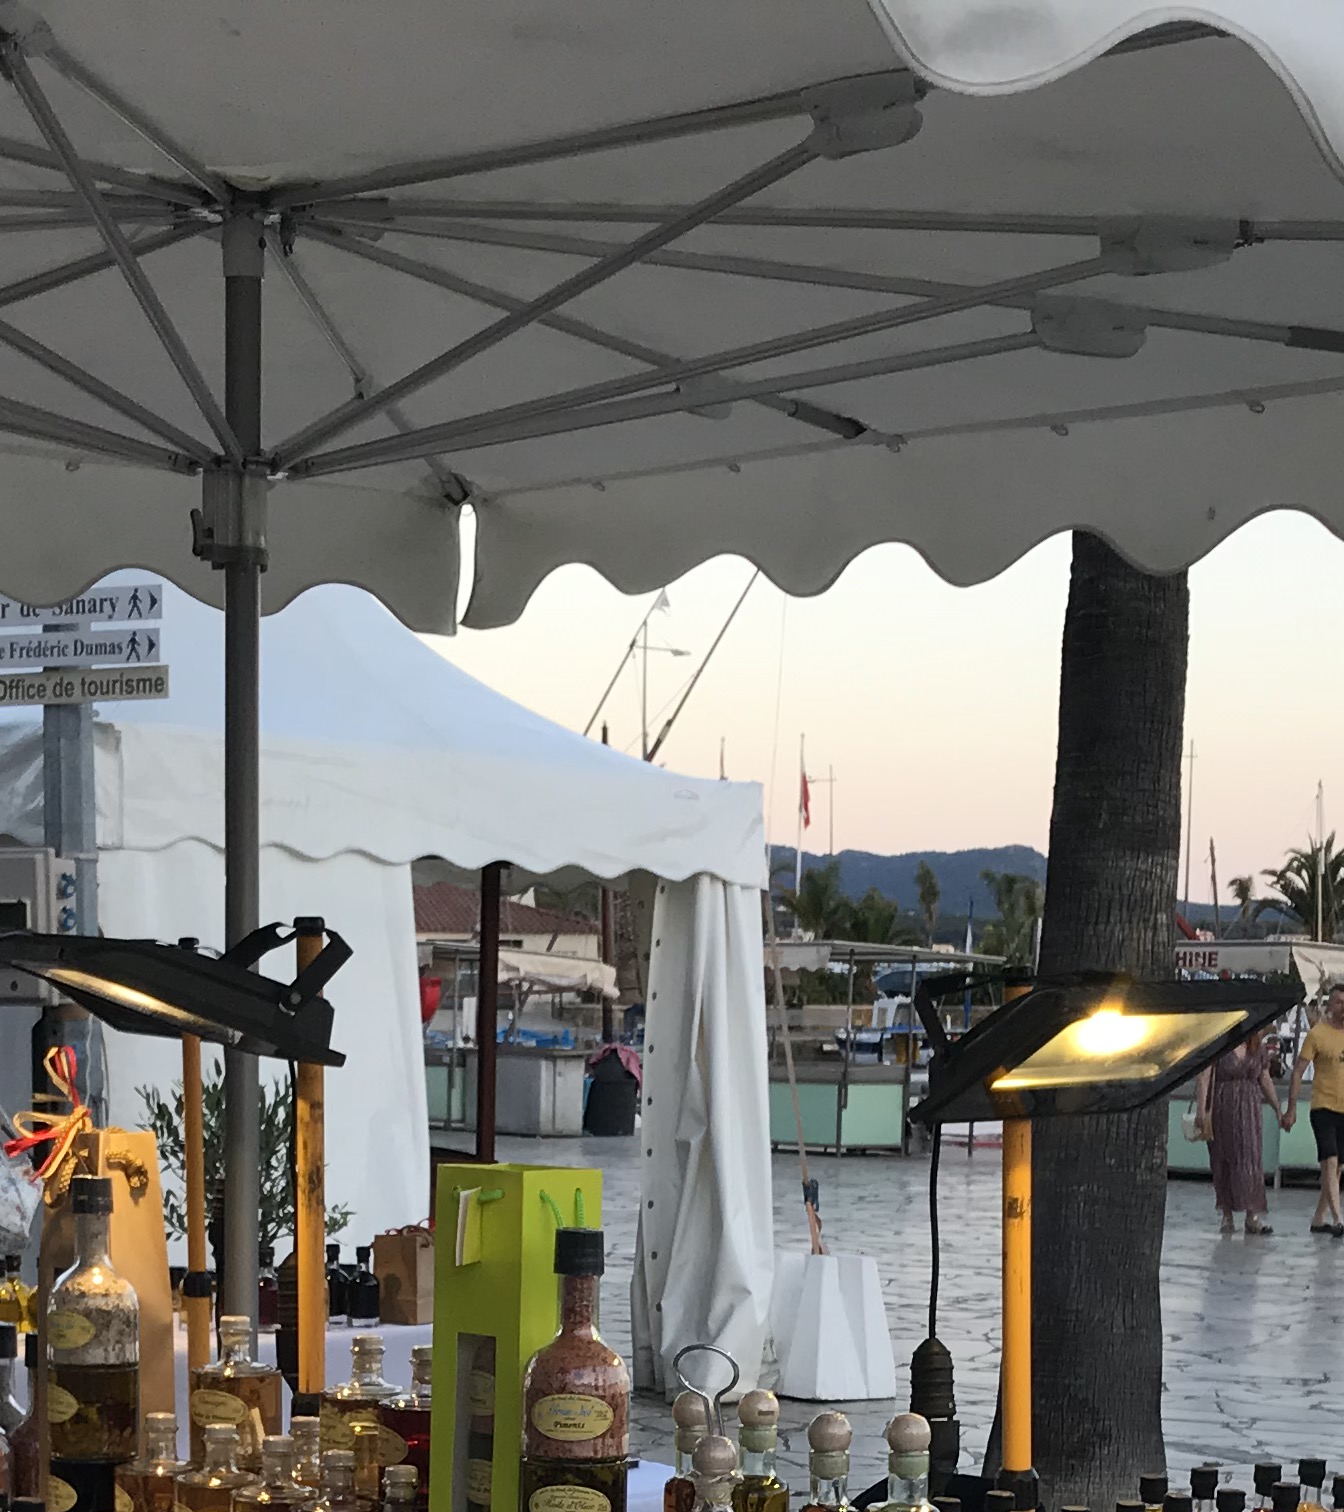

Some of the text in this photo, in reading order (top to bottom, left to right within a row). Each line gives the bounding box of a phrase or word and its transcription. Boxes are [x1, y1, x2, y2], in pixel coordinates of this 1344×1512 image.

[9, 638, 68, 659] Frédéric
[73, 638, 123, 657] Dumas
[52, 677, 74, 698] de
[80, 672, 165, 696] tourisme
[1176, 949, 1219, 969] HINE
